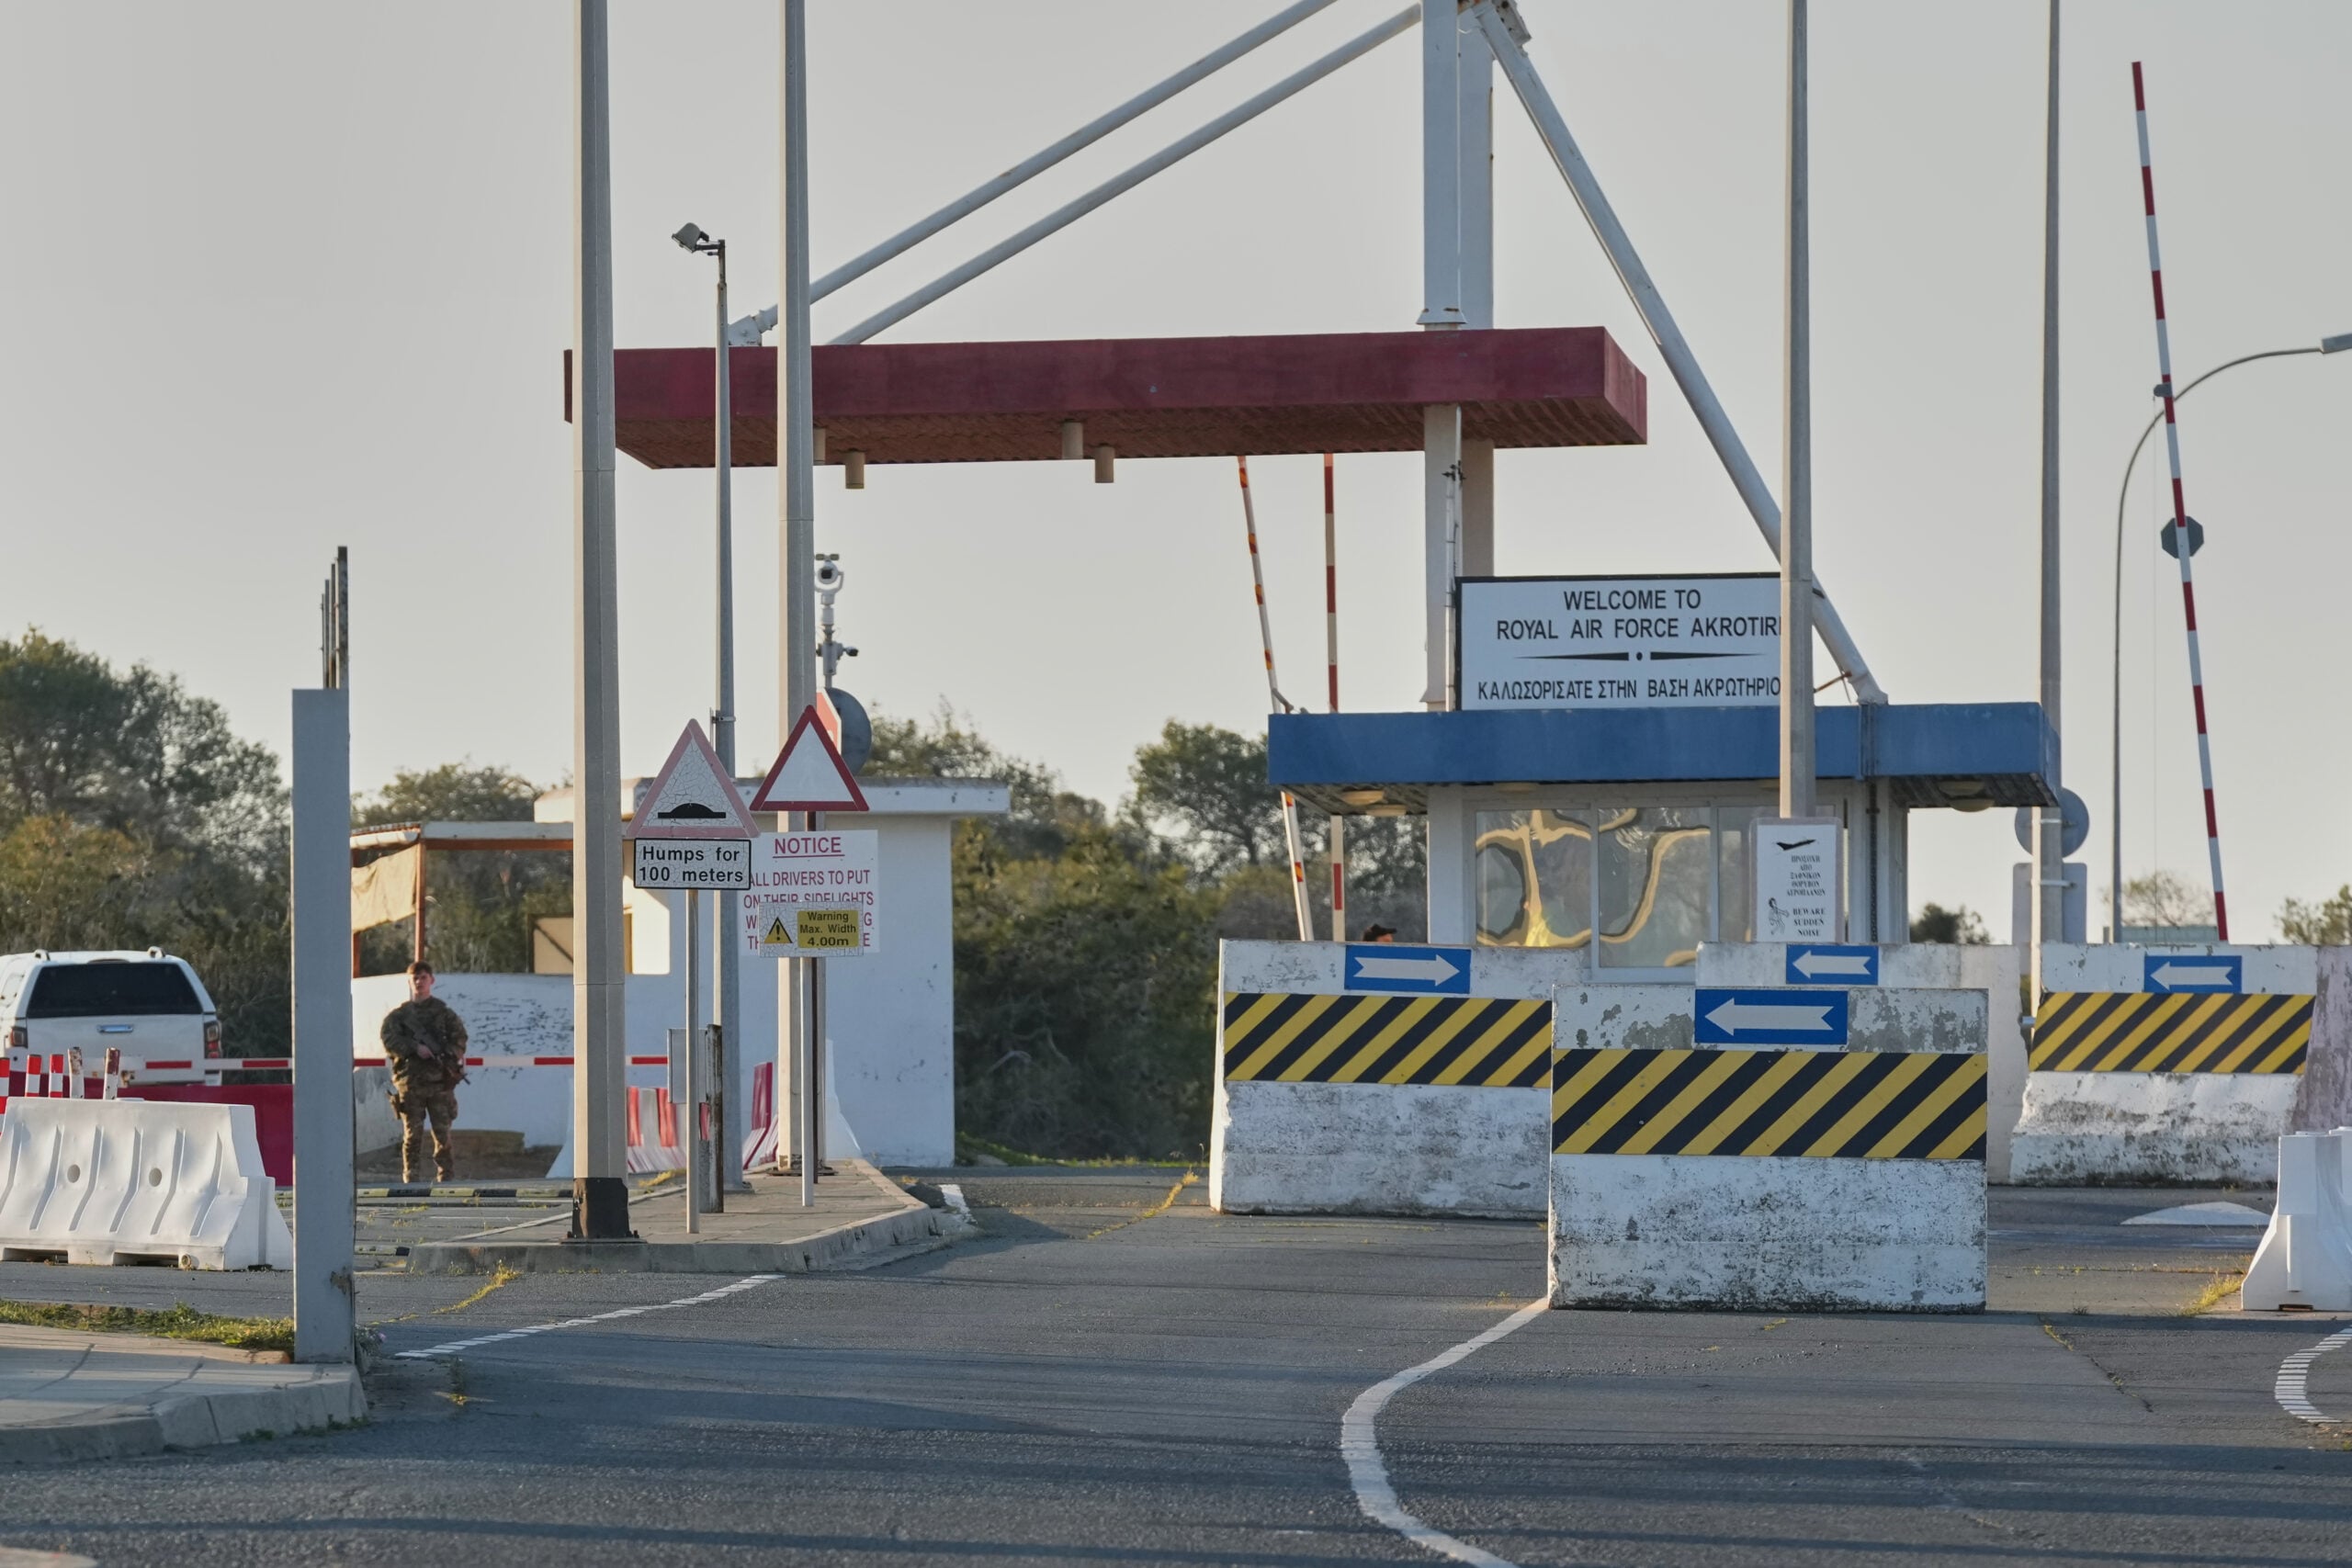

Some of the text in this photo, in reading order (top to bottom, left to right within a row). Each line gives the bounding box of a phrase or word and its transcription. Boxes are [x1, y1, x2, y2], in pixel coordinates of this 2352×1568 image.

[1563, 589, 1702, 611] WELCOME TO
[1497, 619, 1559, 640] ROYAL
[1570, 618, 1603, 639] AIR
[1614, 616, 1679, 638] FORCE
[1477, 676, 1781, 700] ΚΑΛΩΣΟΡΙΣΑΤΕ ΣΤΗΝ ΒΑΣΗ ΑΚΡΩΤΗΡΙΟ
[642, 845, 741, 863] Humps for
[775, 837, 842, 854] NOTICE
[639, 866, 743, 883] 100 meters
[773, 871, 825, 886] DRIVERS
[828, 870, 844, 885] TO
[847, 869, 871, 885] PUT
[743, 894, 761, 908] ON
[807, 911, 849, 922] Warning
[1792, 908, 1826, 916] BEWARE
[799, 923, 856, 934] Max. Width
[1798, 929, 1820, 937] NOISE
[807, 937, 849, 946] 4.00m
